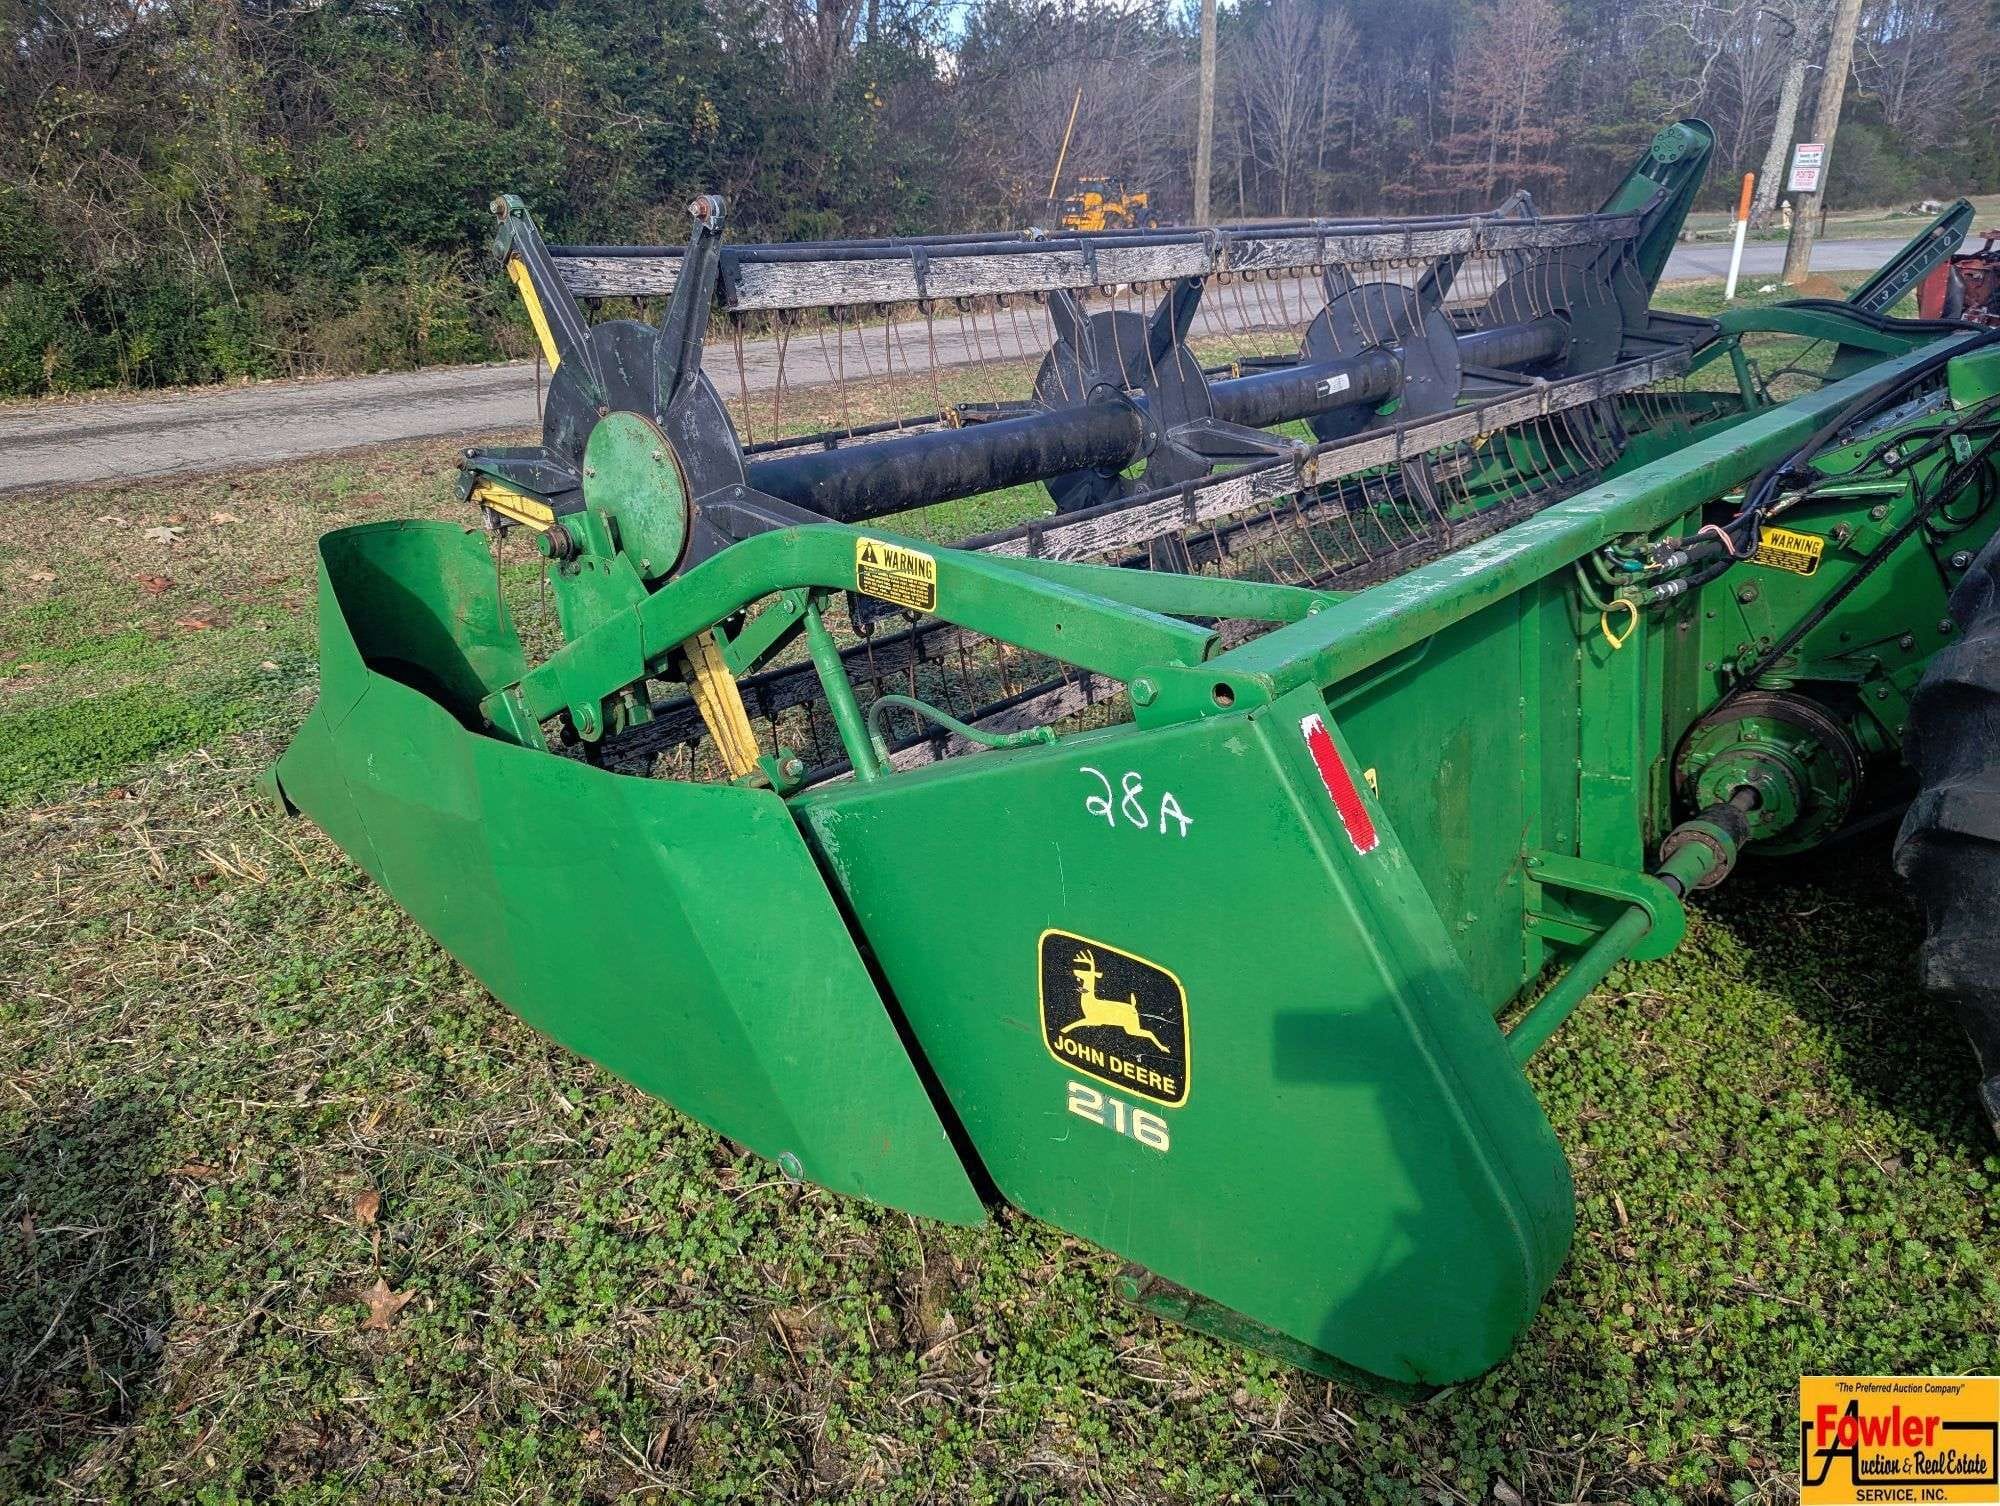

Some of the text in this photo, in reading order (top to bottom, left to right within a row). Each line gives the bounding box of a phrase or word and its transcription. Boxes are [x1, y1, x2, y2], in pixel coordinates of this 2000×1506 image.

[1943, 236, 1951, 246] 0
[1902, 272, 1909, 282] 2
[1881, 290, 1889, 300] 3
[1771, 532, 1820, 554] WARNING
[883, 548, 932, 580] WARNING
[1054, 1034, 1176, 1096] JOHN DEERE
[1066, 1080, 1170, 1152] 216
